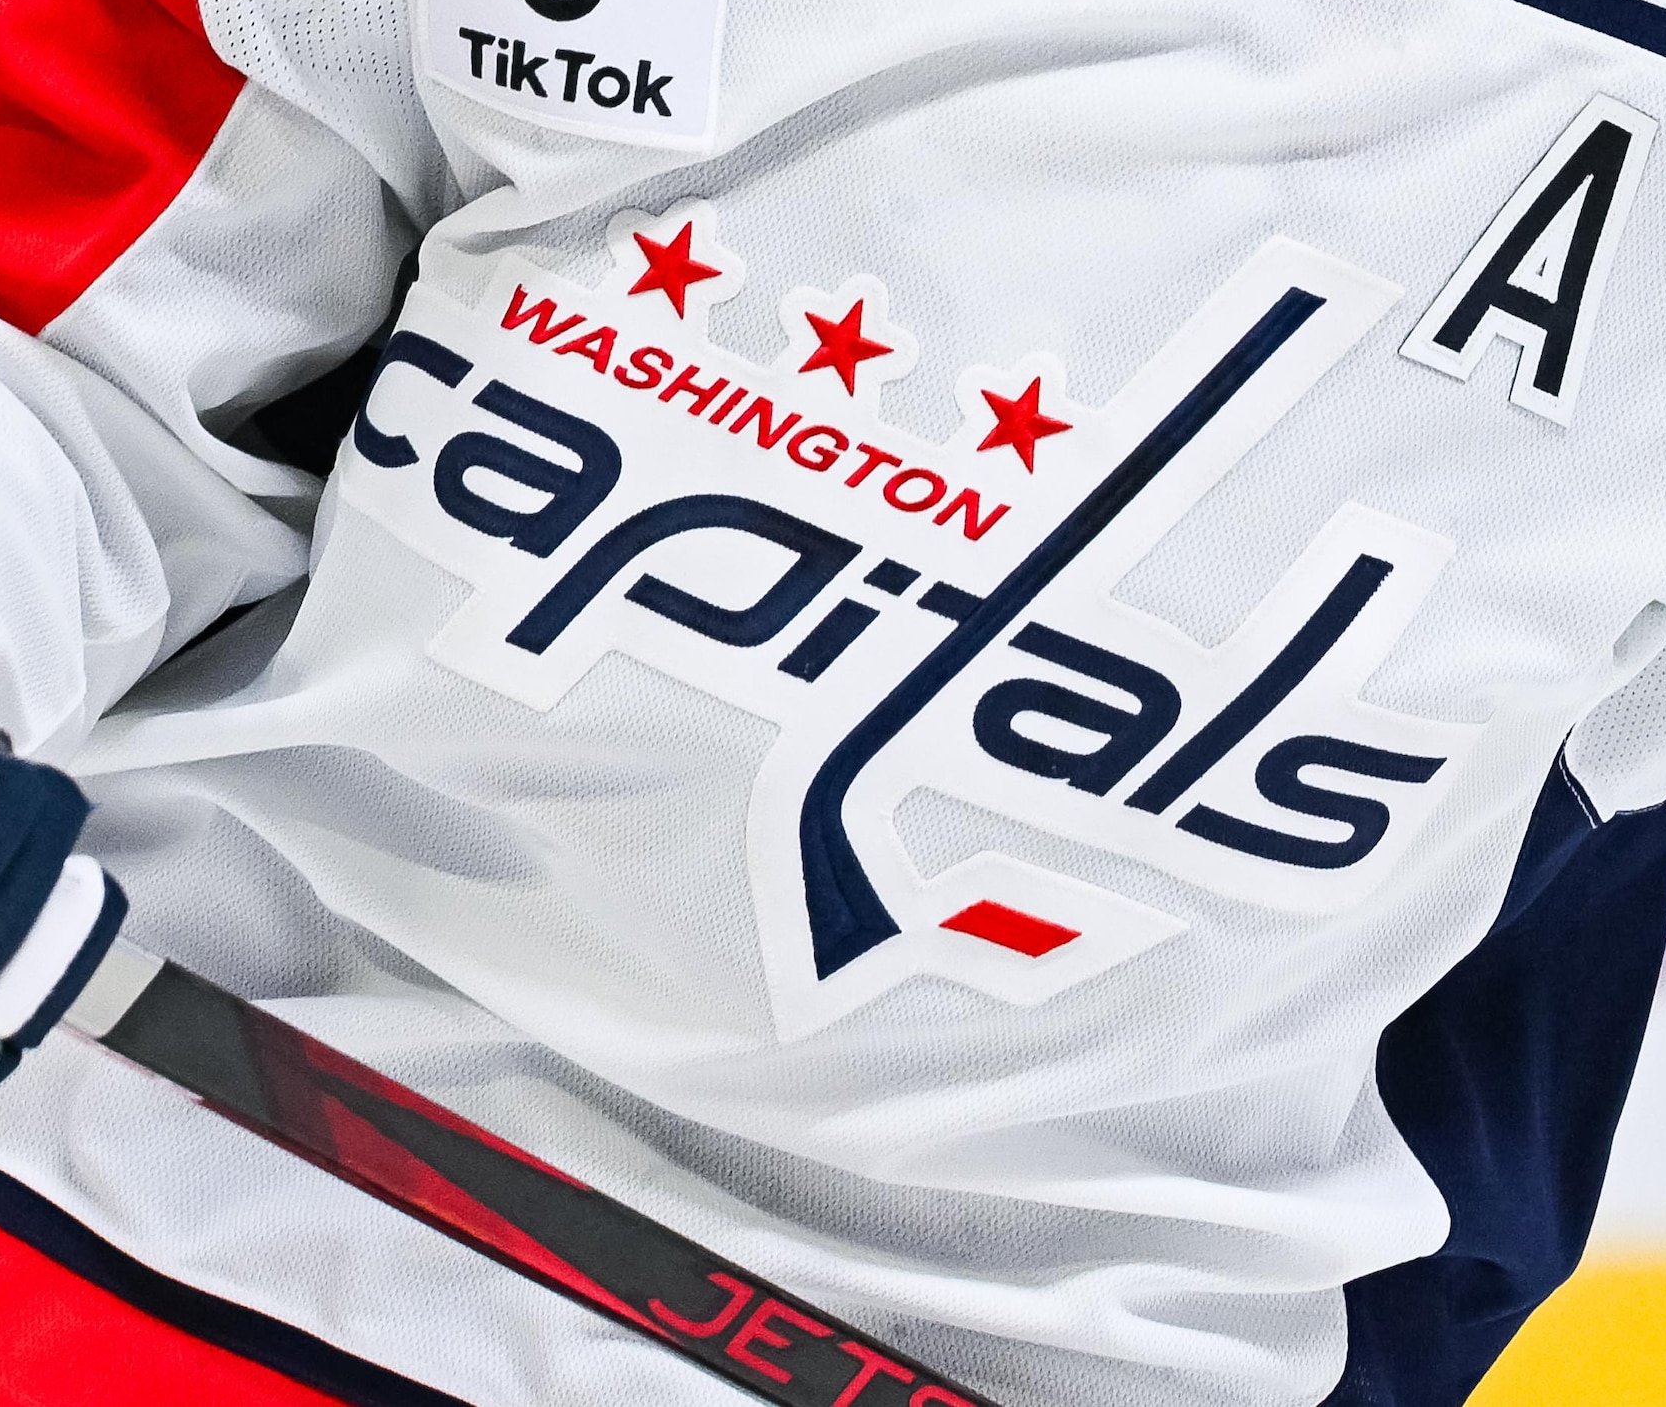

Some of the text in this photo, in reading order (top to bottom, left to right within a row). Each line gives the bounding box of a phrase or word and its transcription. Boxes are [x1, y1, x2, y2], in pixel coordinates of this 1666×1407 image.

[458, 26, 674, 118] TikTok
[1432, 119, 1633, 397] A
[499, 283, 1012, 542] WASHINGTON
[353, 286, 1449, 982] capitals
